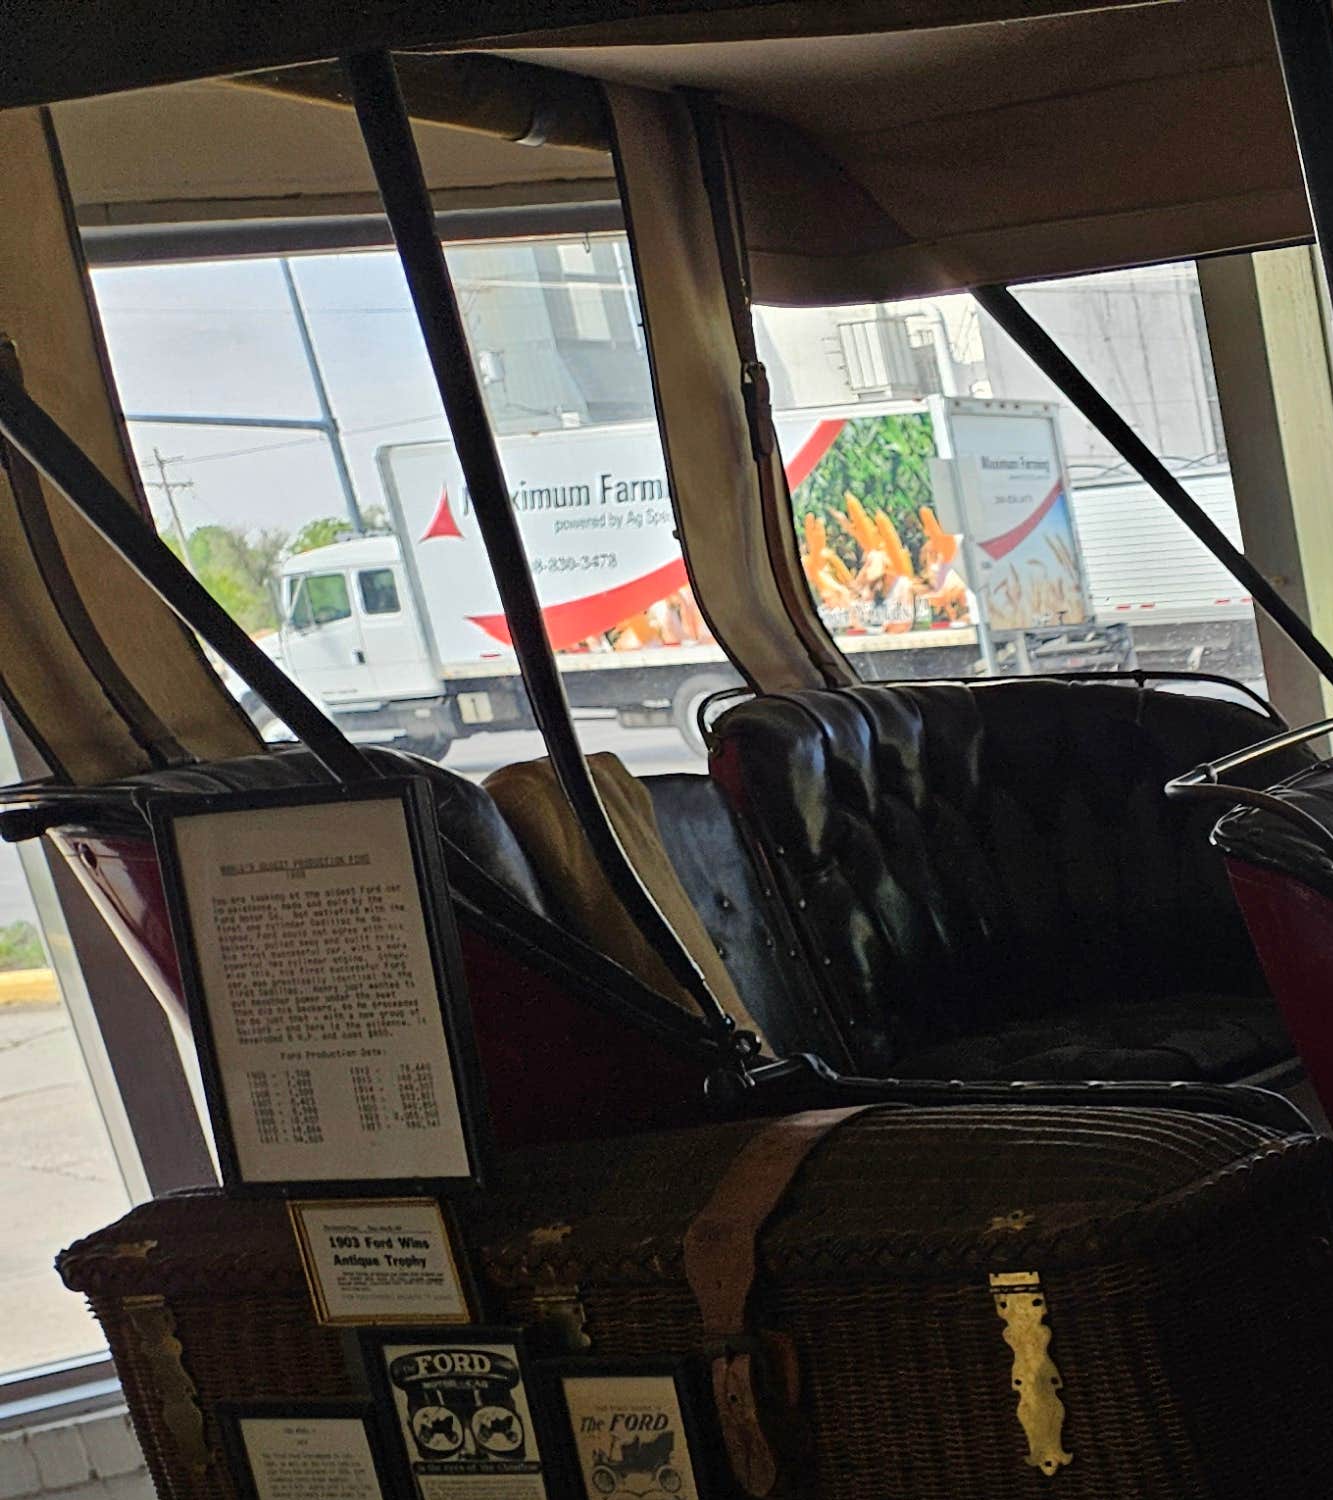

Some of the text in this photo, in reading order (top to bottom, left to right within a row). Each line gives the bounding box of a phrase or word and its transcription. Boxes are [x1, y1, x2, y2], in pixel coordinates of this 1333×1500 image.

[329, 1236, 430, 1250] 1903 Ford Wins
[334, 1254, 426, 1269] Antique Trophy
[415, 1352, 492, 1376] FORD
[580, 1413, 669, 1433] The FORD
